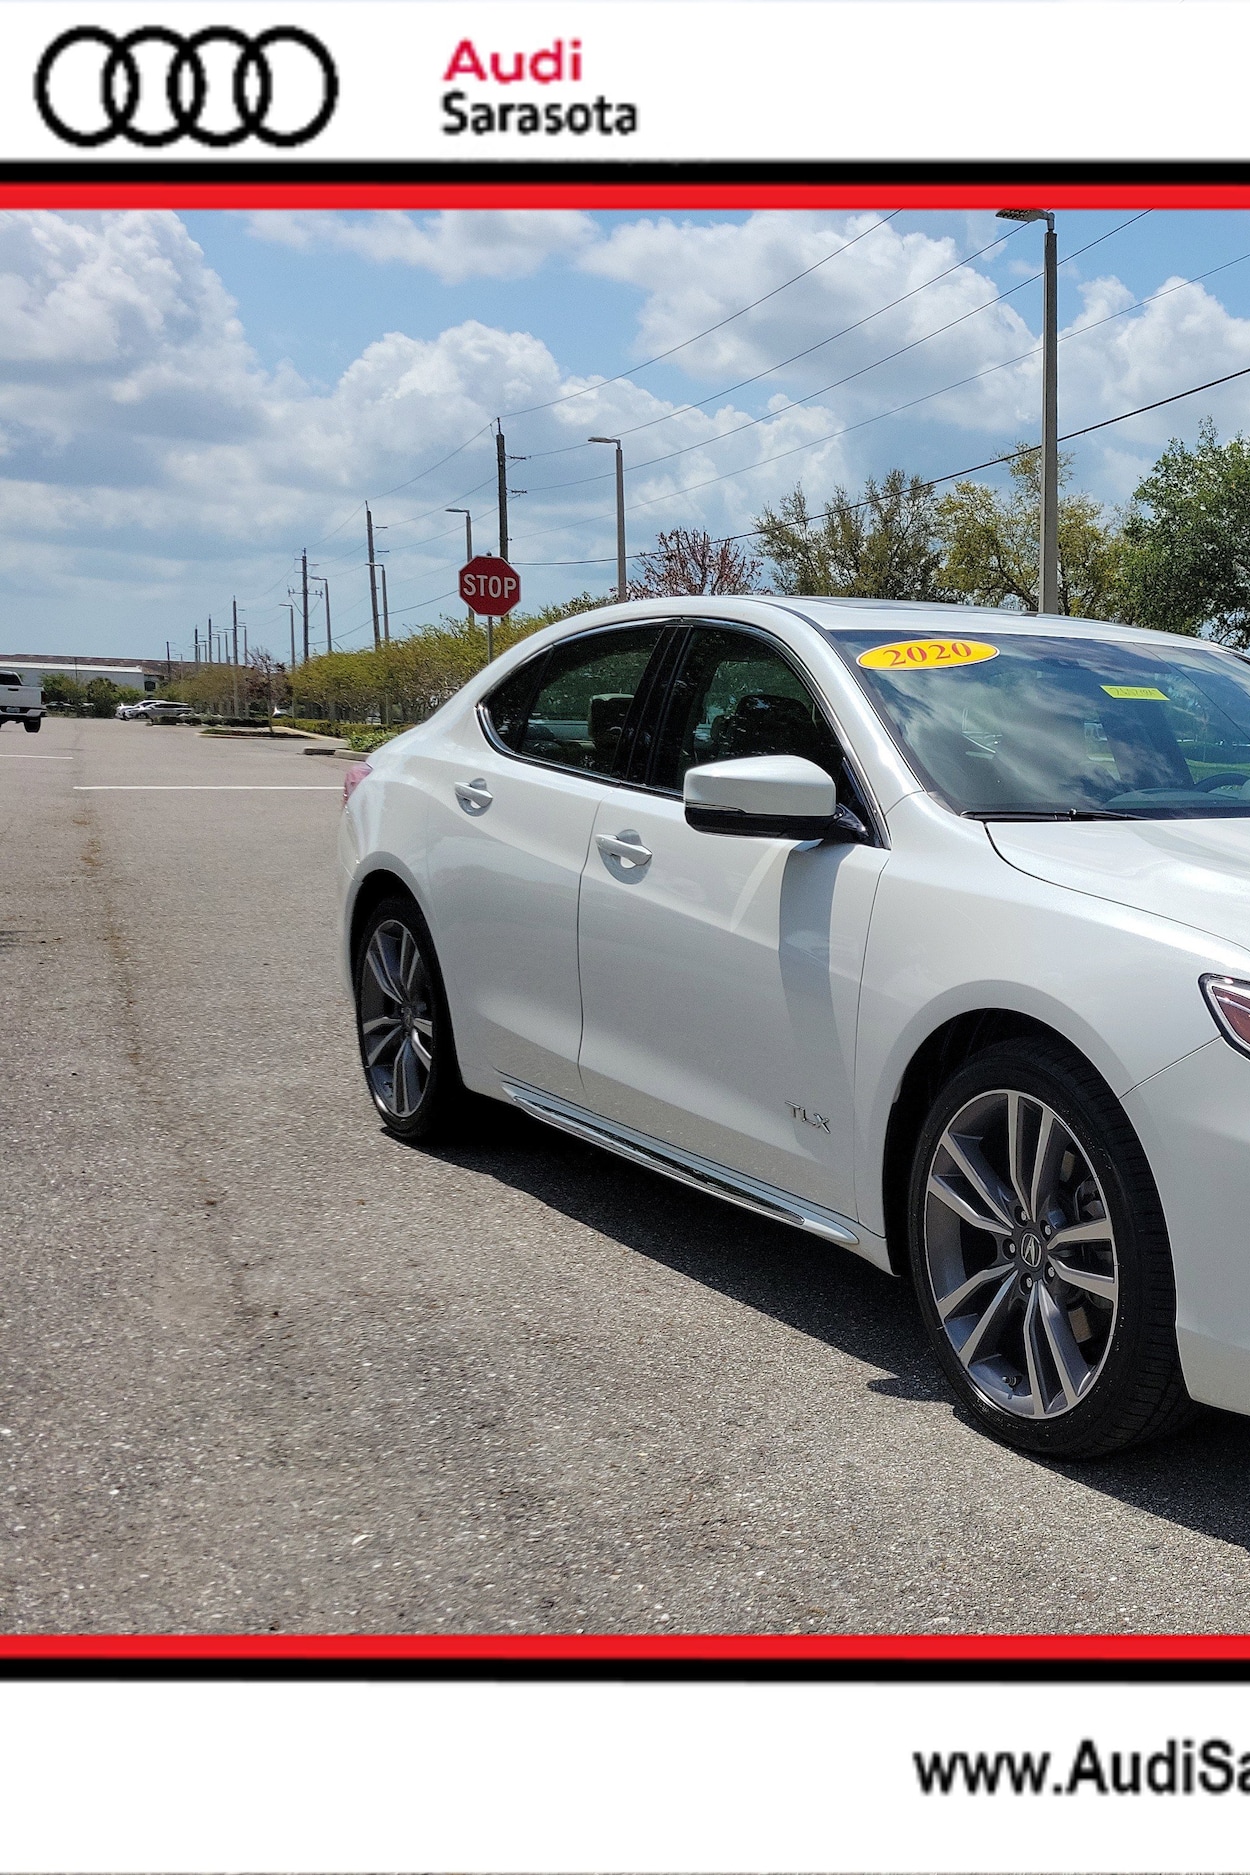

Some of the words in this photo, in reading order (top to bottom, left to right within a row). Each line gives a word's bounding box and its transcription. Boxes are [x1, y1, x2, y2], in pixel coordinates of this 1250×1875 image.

[463, 573, 517, 599] STOP
[882, 642, 972, 666] 2020
[785, 1101, 830, 1134] TLX
